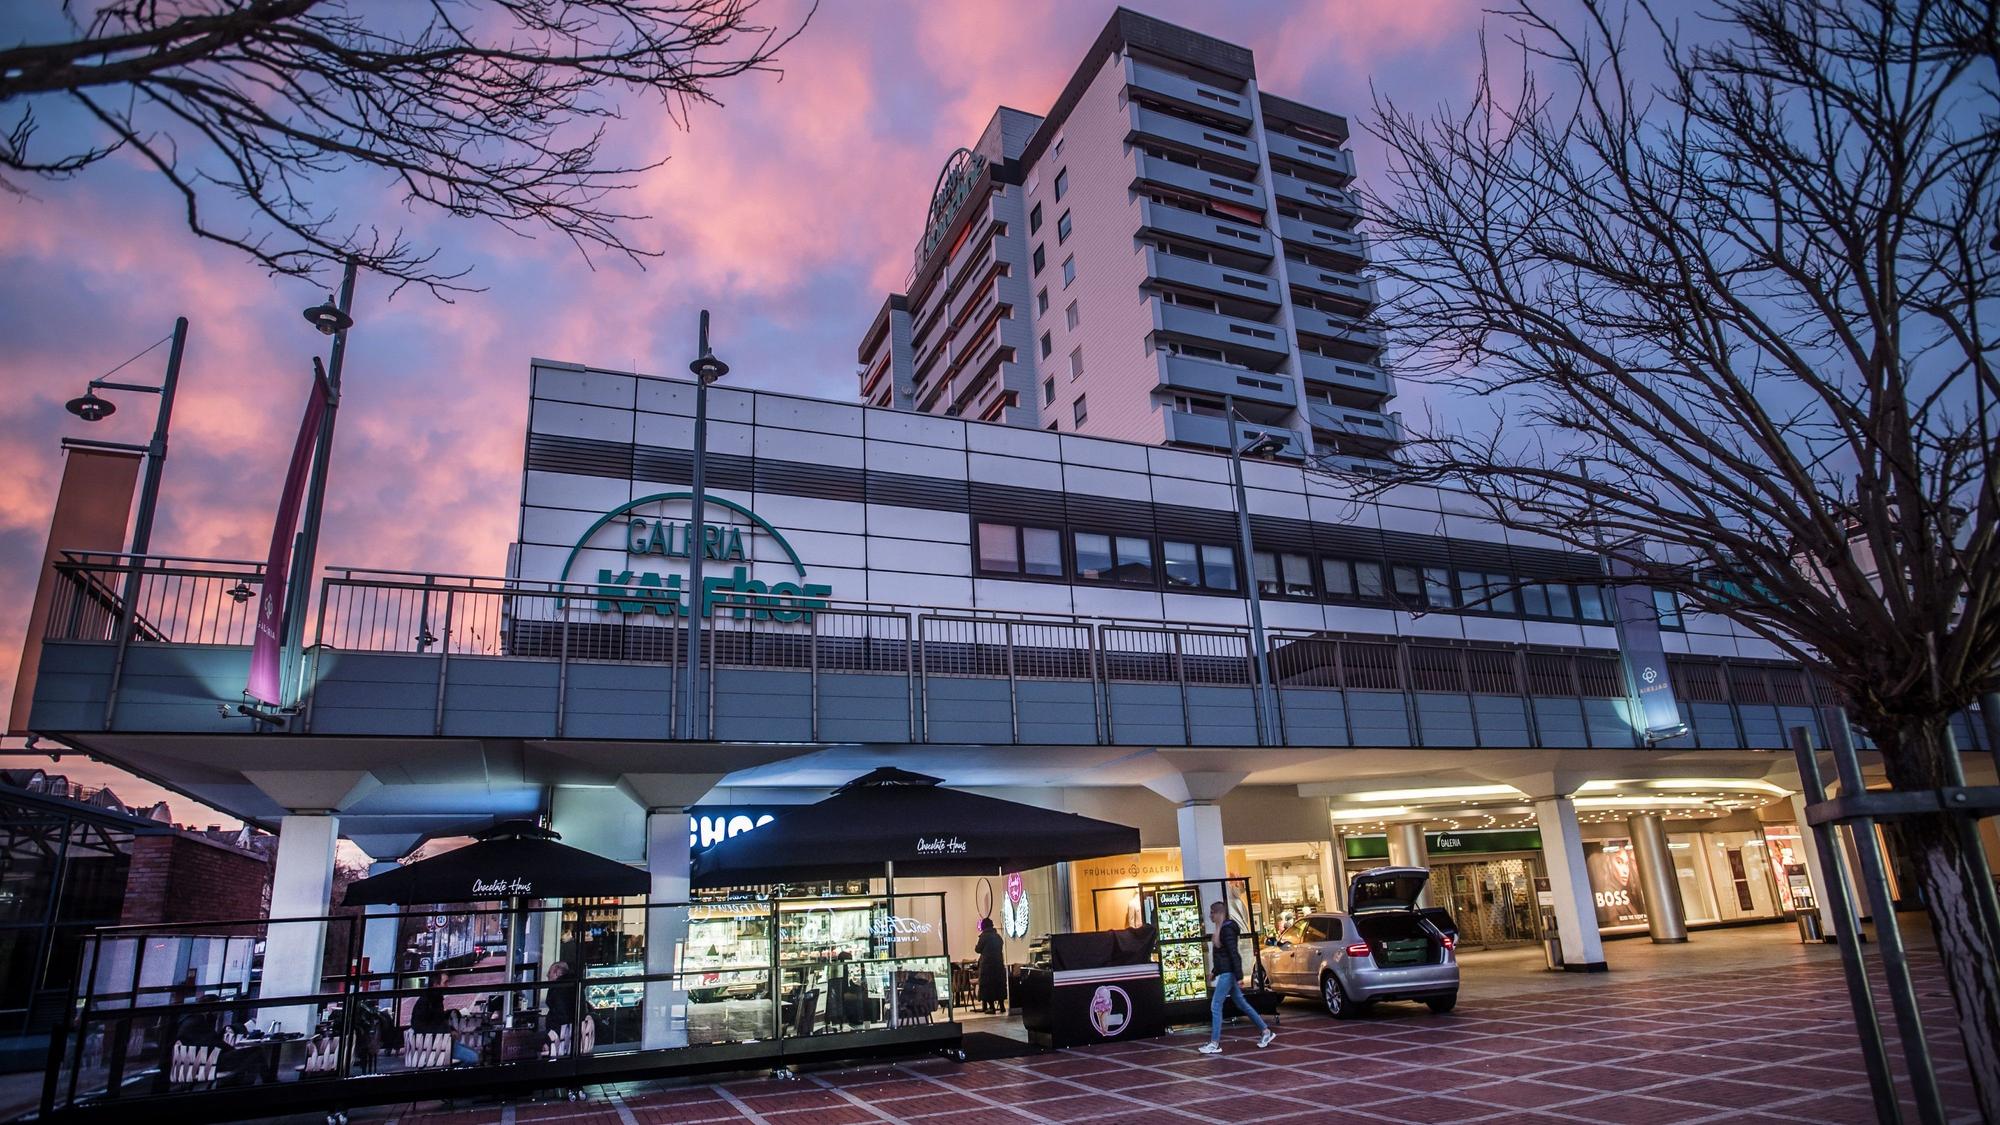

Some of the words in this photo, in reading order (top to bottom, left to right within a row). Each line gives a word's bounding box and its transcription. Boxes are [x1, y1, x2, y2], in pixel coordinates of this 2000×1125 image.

[627, 518, 746, 561] GALERIA
[690, 814, 775, 848] HO
[917, 837, 945, 852] Chocolate
[946, 836, 967, 852] Haus
[1440, 837, 1462, 848] GALERIA
[1083, 867, 1126, 877] FRÜHLING
[1142, 865, 1180, 874] GALERIA
[472, 878, 507, 894] Chocolate
[508, 877, 532, 895] Haus
[1595, 889, 1630, 908] BOSS
